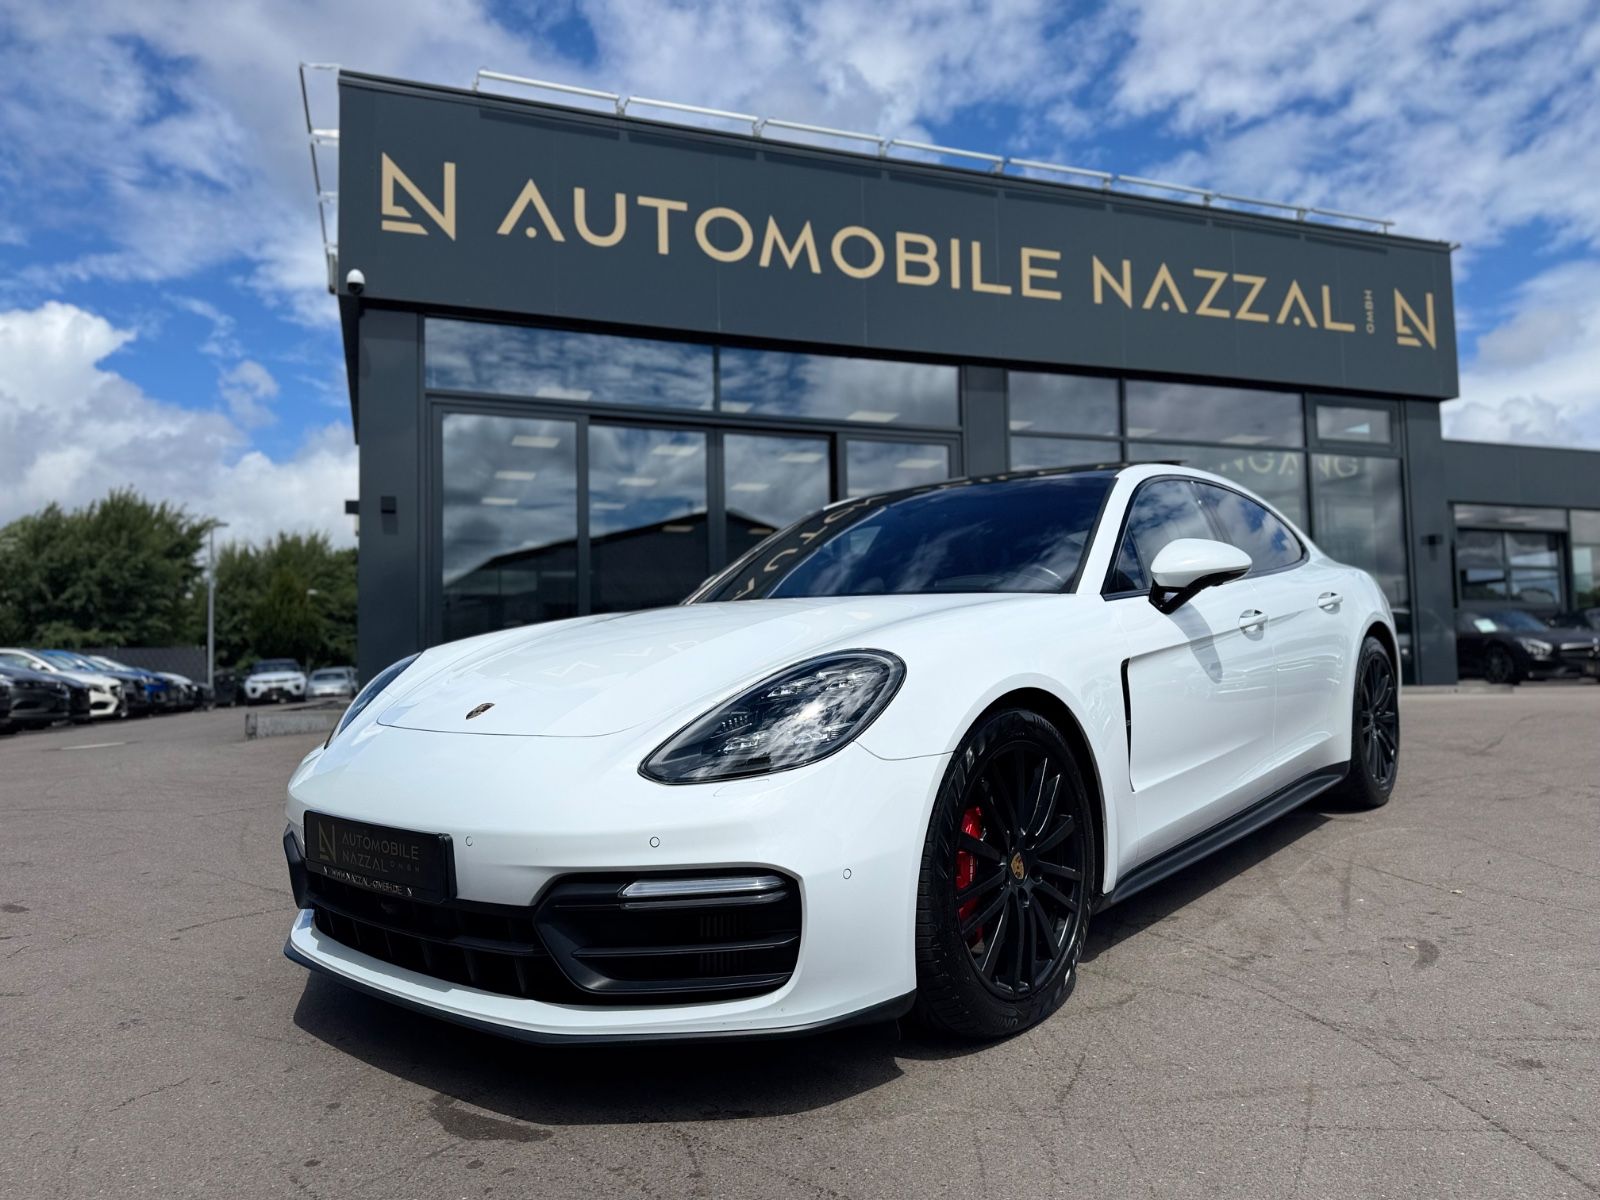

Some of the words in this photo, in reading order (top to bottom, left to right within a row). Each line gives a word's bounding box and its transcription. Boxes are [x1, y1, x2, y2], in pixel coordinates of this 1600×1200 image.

[497, 178, 1063, 301] AUTOMOBILE
[1092, 255, 1356, 331] NAZZAL
[342, 831, 420, 860] AUTOMOBILE
[342, 850, 388, 873] NAZZAL
